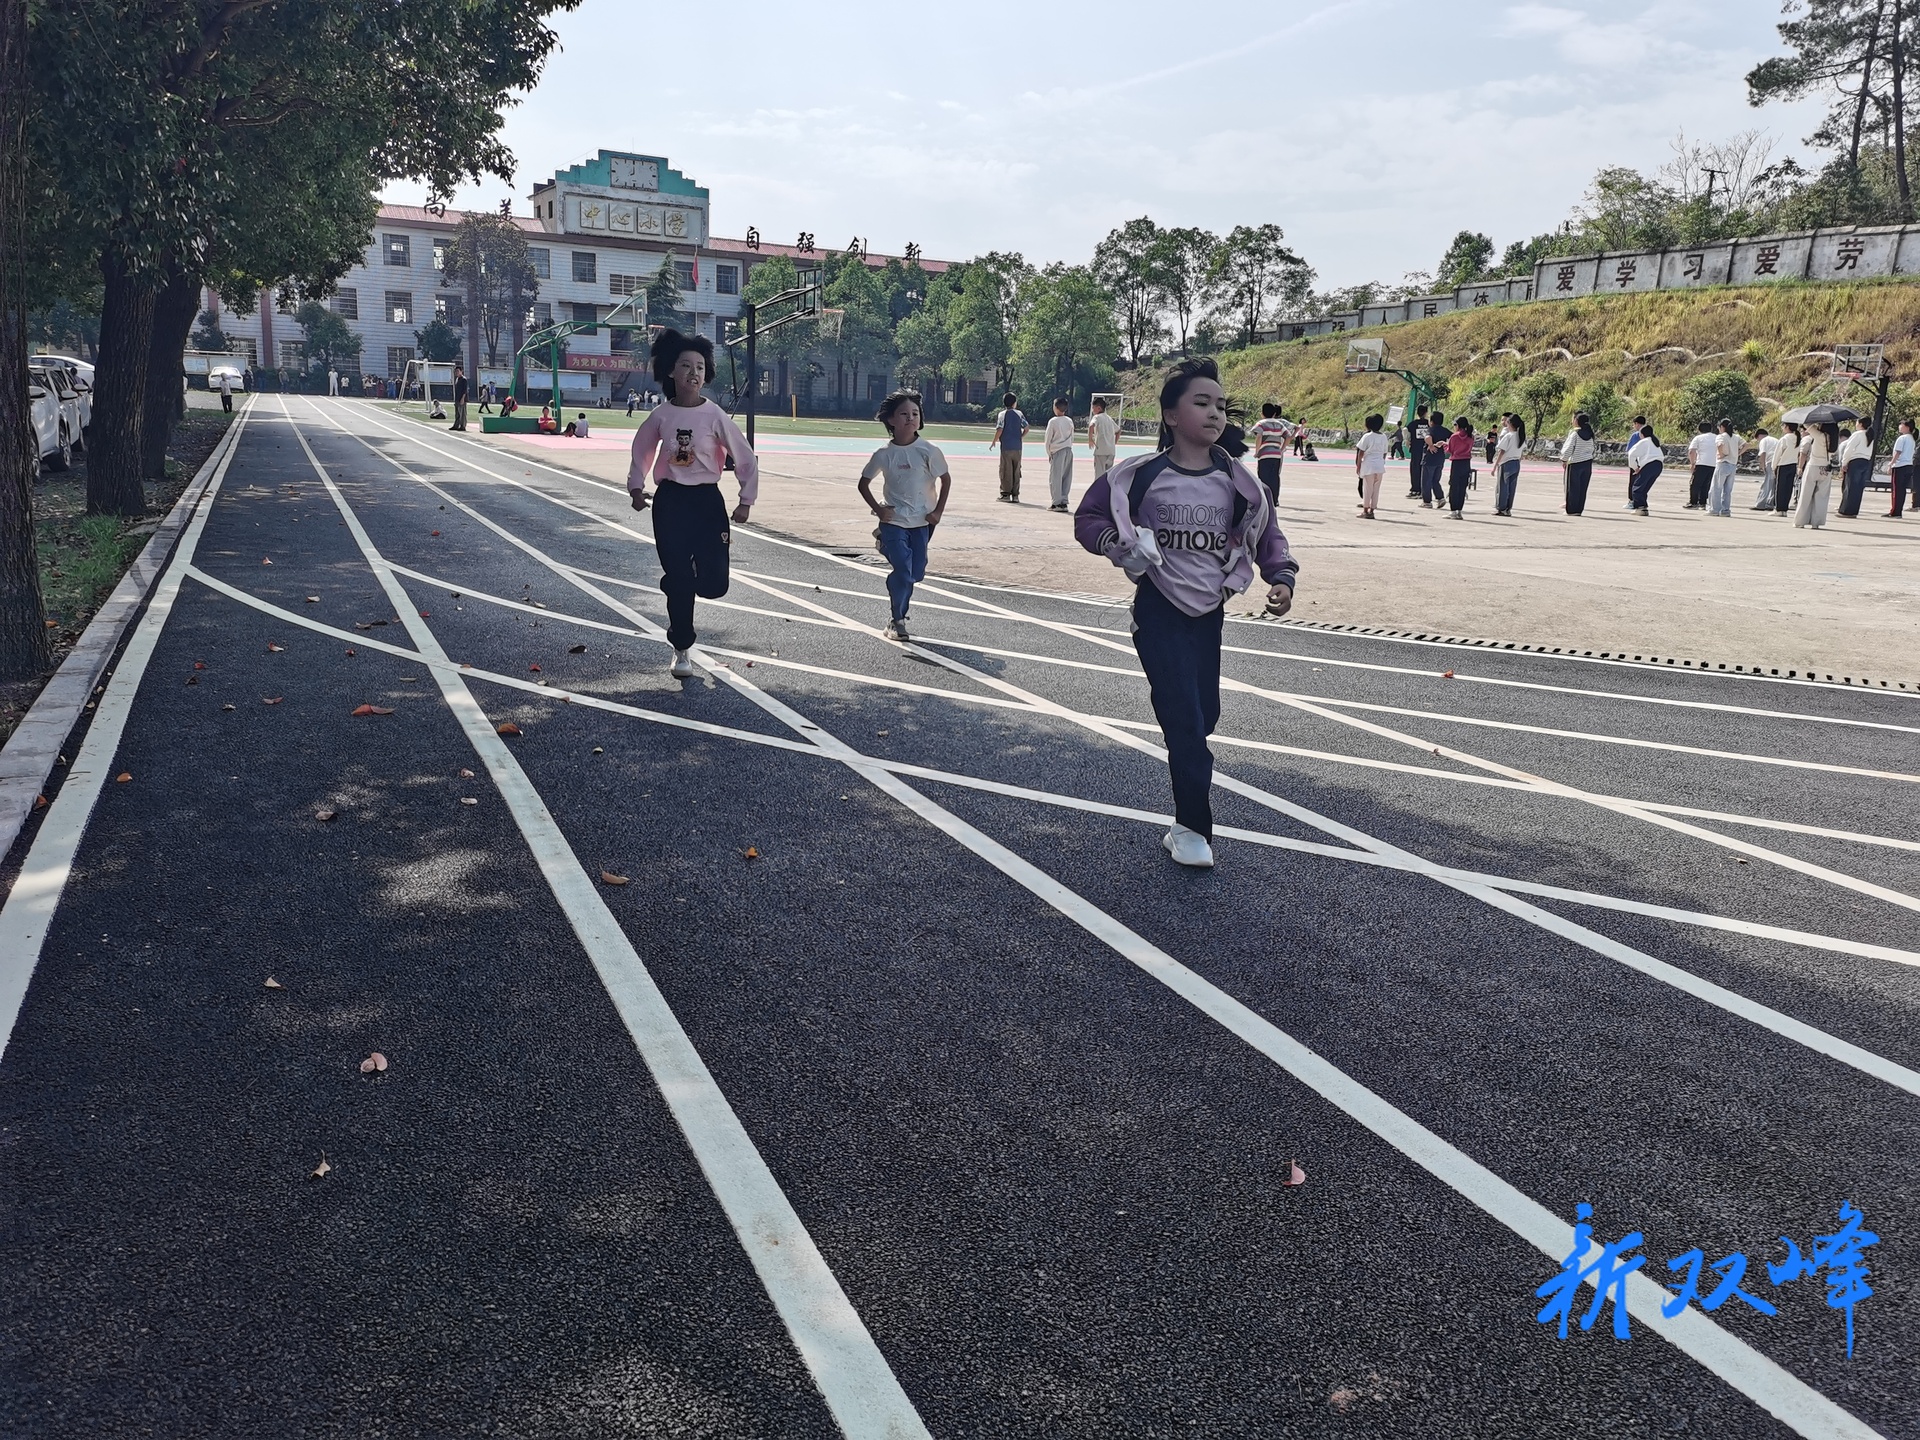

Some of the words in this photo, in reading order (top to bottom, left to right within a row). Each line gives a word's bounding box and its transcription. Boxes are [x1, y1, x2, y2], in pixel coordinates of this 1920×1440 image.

[585, 203, 685, 235] 中心小学
[747, 226, 922, 263] 自强创新
[572, 357, 607, 368] 为党育人
